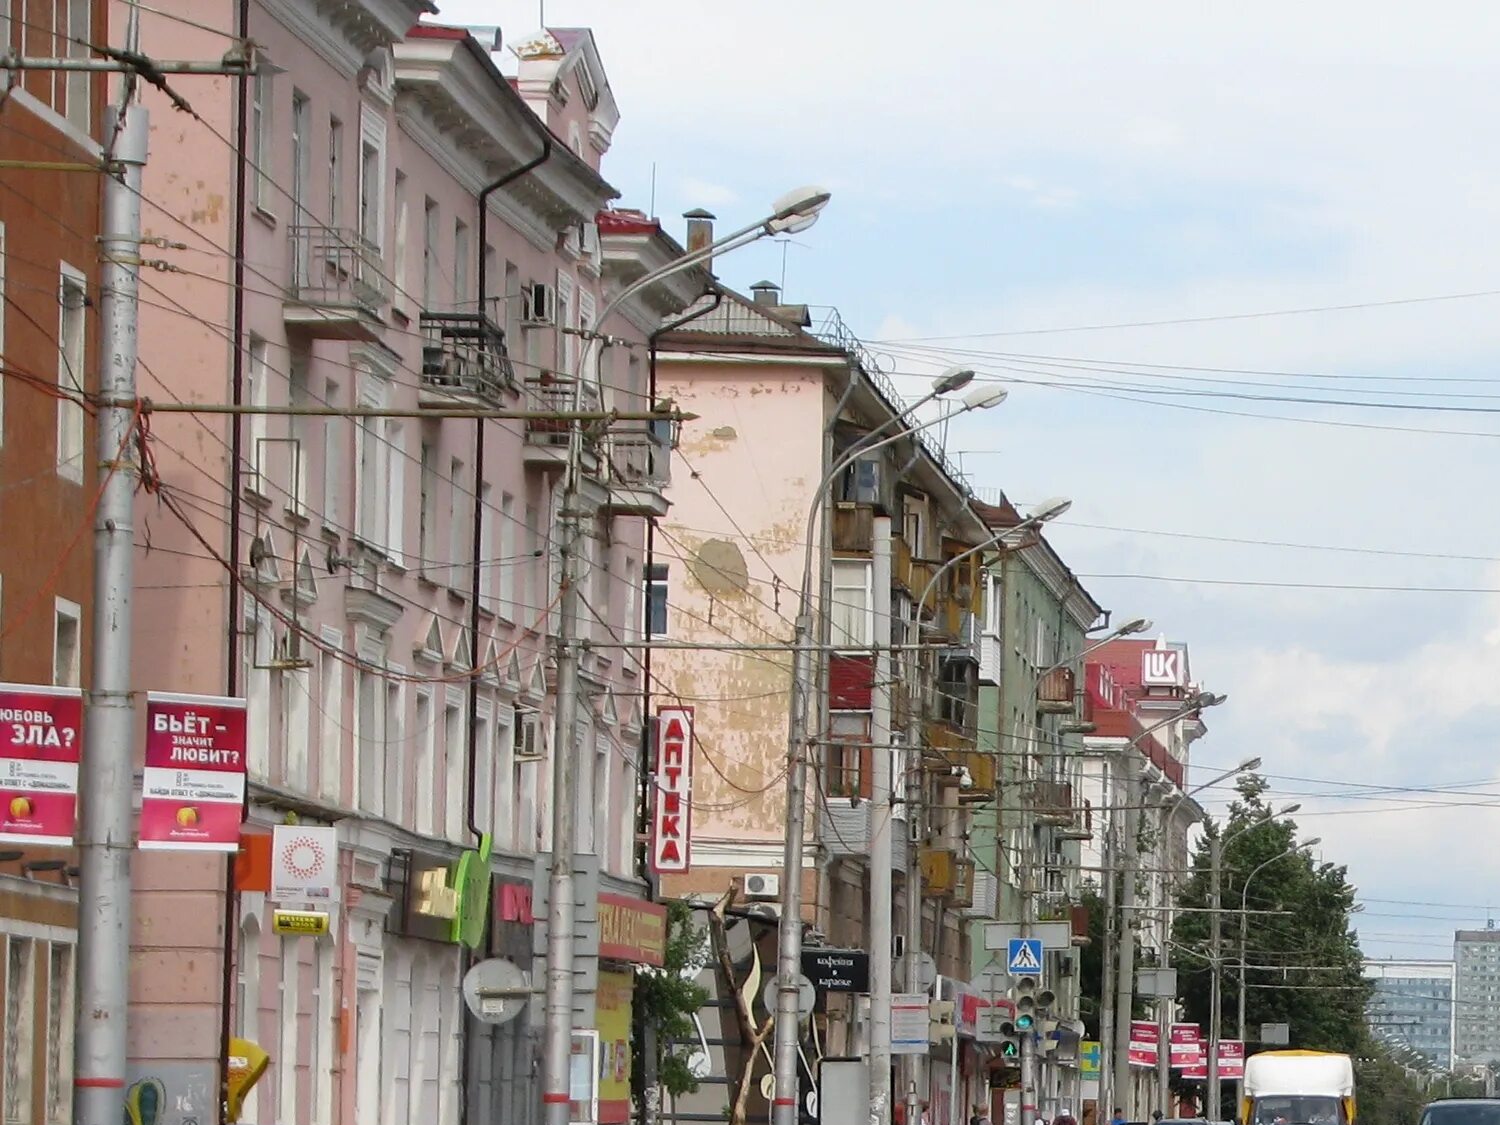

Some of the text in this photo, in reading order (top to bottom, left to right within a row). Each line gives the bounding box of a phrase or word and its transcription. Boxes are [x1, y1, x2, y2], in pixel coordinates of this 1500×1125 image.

[154, 712, 210, 734] БЬЁТ
[10, 724, 76, 748] ЗЛА?
[171, 736, 214, 747] ЗНАЧИТ
[169, 748, 240, 765] ЛЮБИТ?
[661, 717, 685, 864] АПТЕКА
